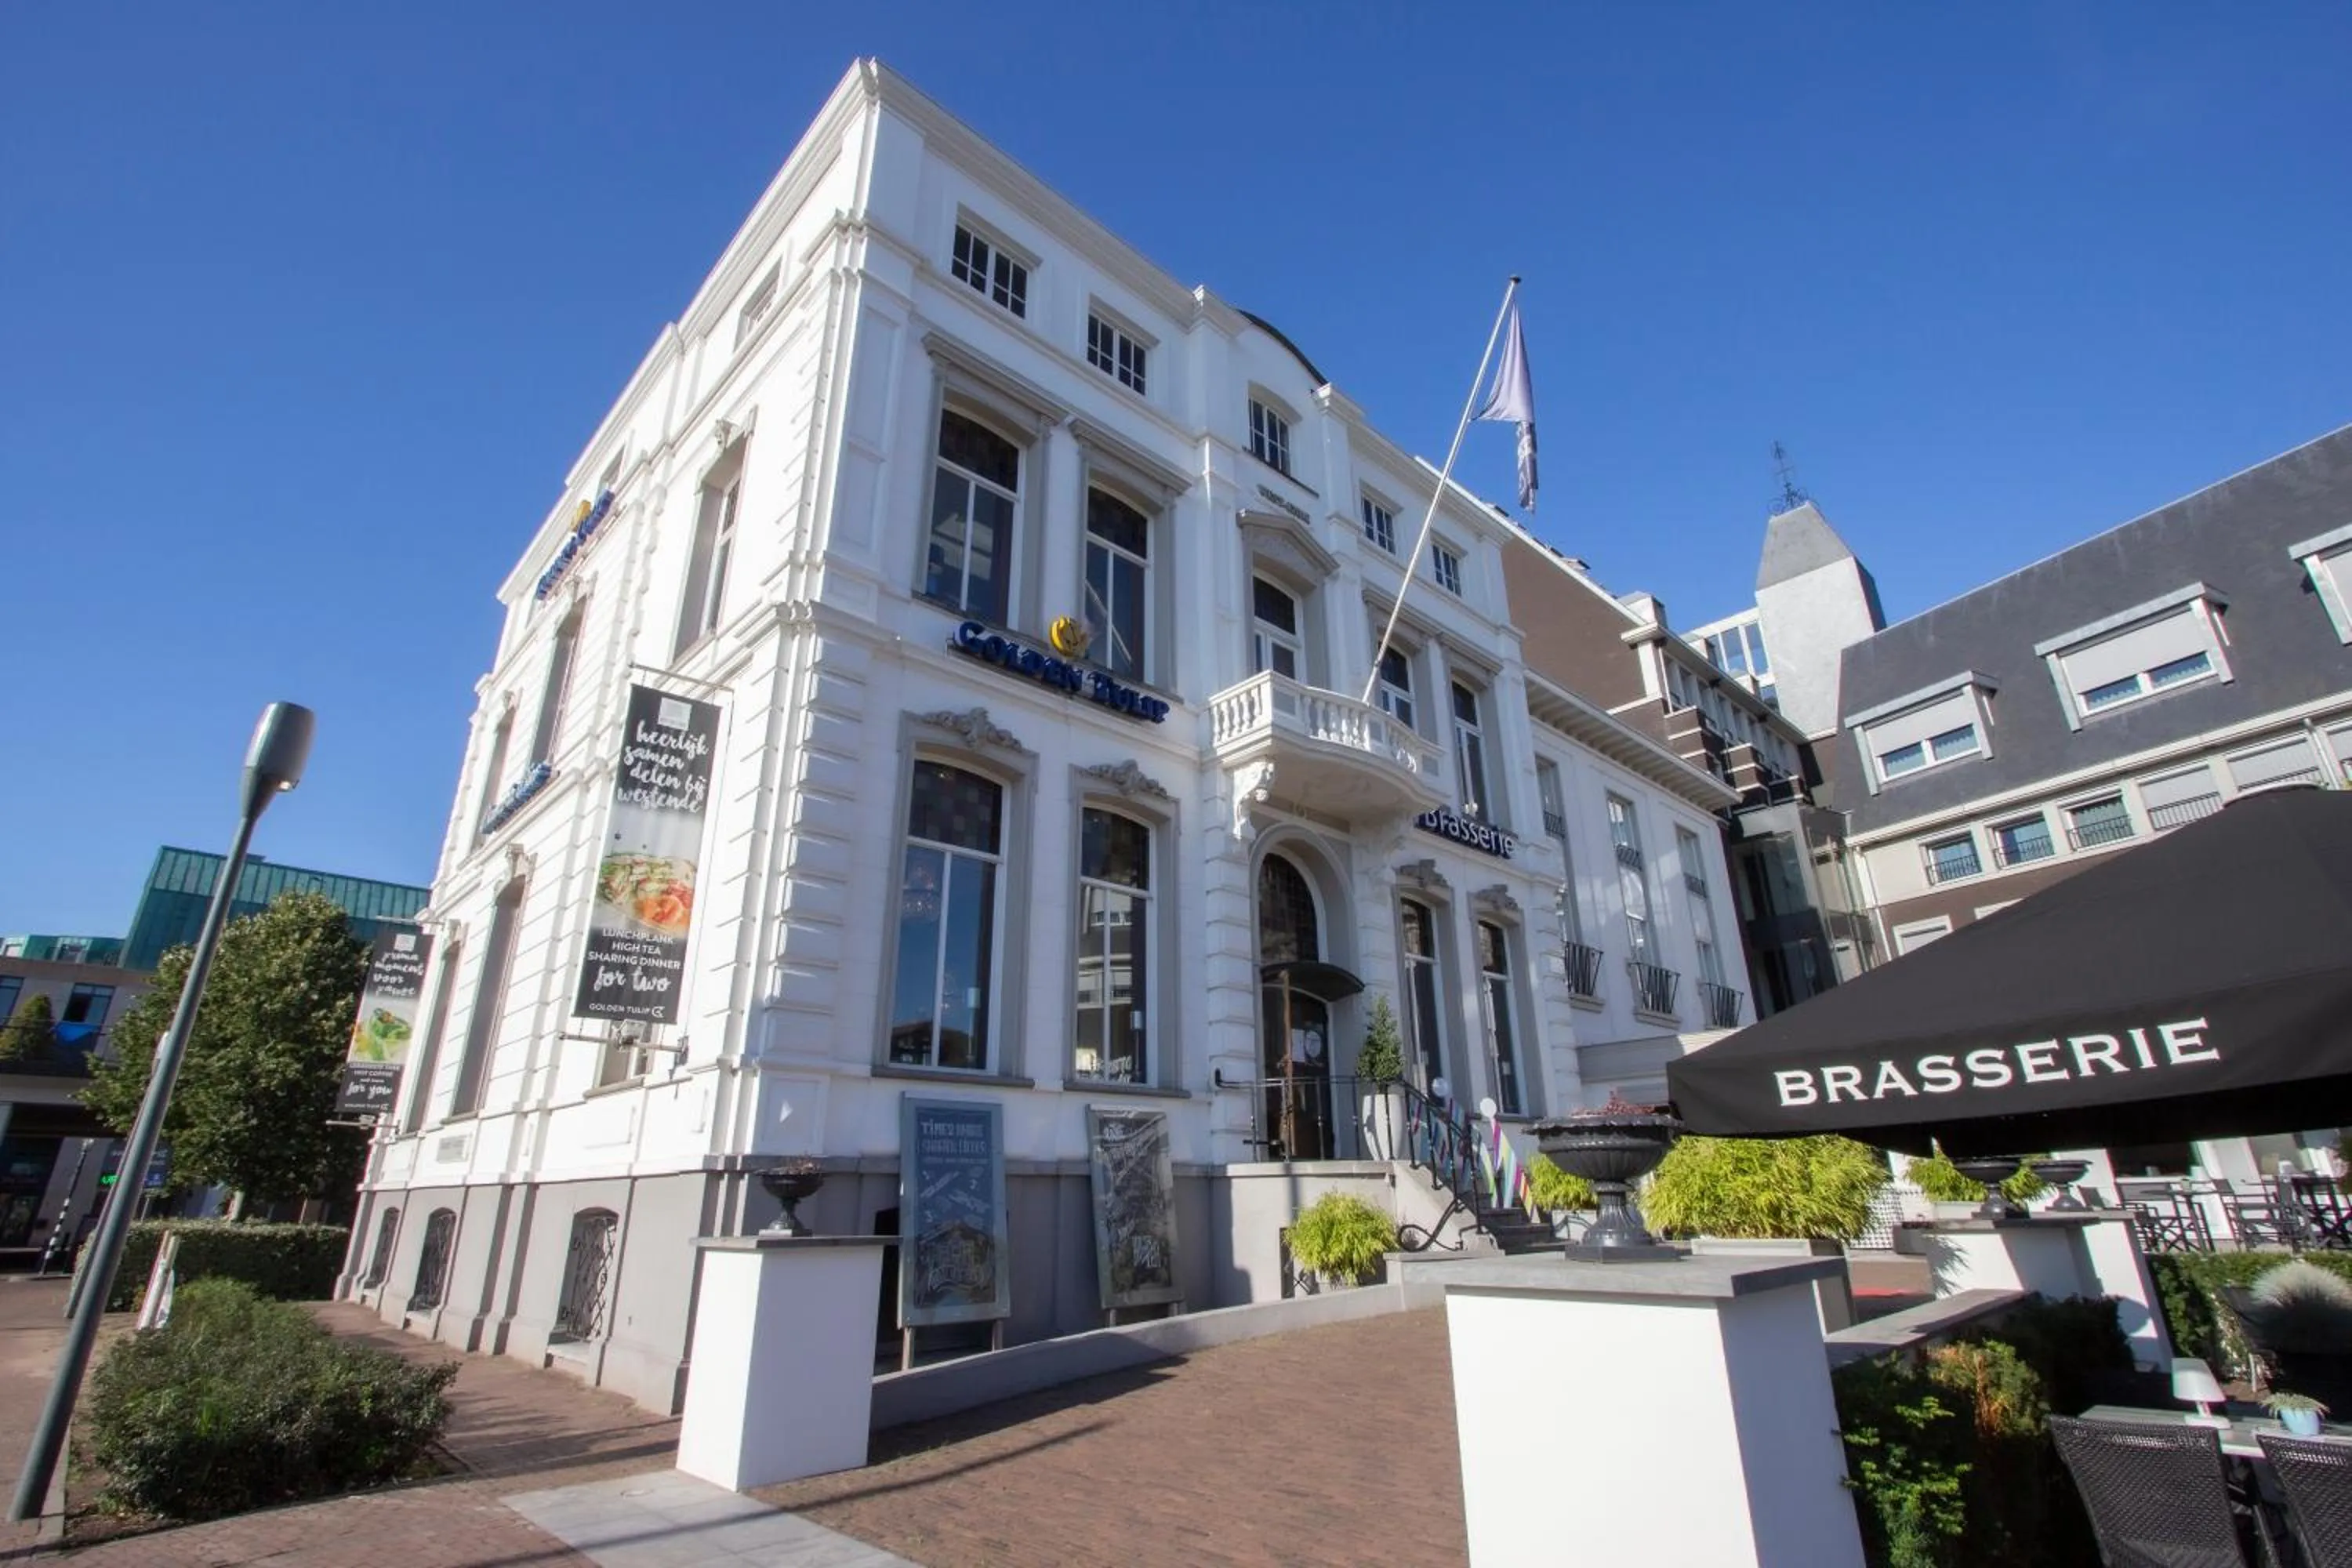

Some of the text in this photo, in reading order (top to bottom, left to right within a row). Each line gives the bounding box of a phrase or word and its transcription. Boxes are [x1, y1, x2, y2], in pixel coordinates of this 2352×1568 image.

[630, 760, 681, 789] delen
[612, 941, 662, 956] HIGH TEA
[587, 951, 681, 971] SHARING DINNER
[593, 965, 672, 992] for two
[589, 1003, 625, 1013] GOLDEN
[1773, 1017, 2221, 1107] BRASSERIE
